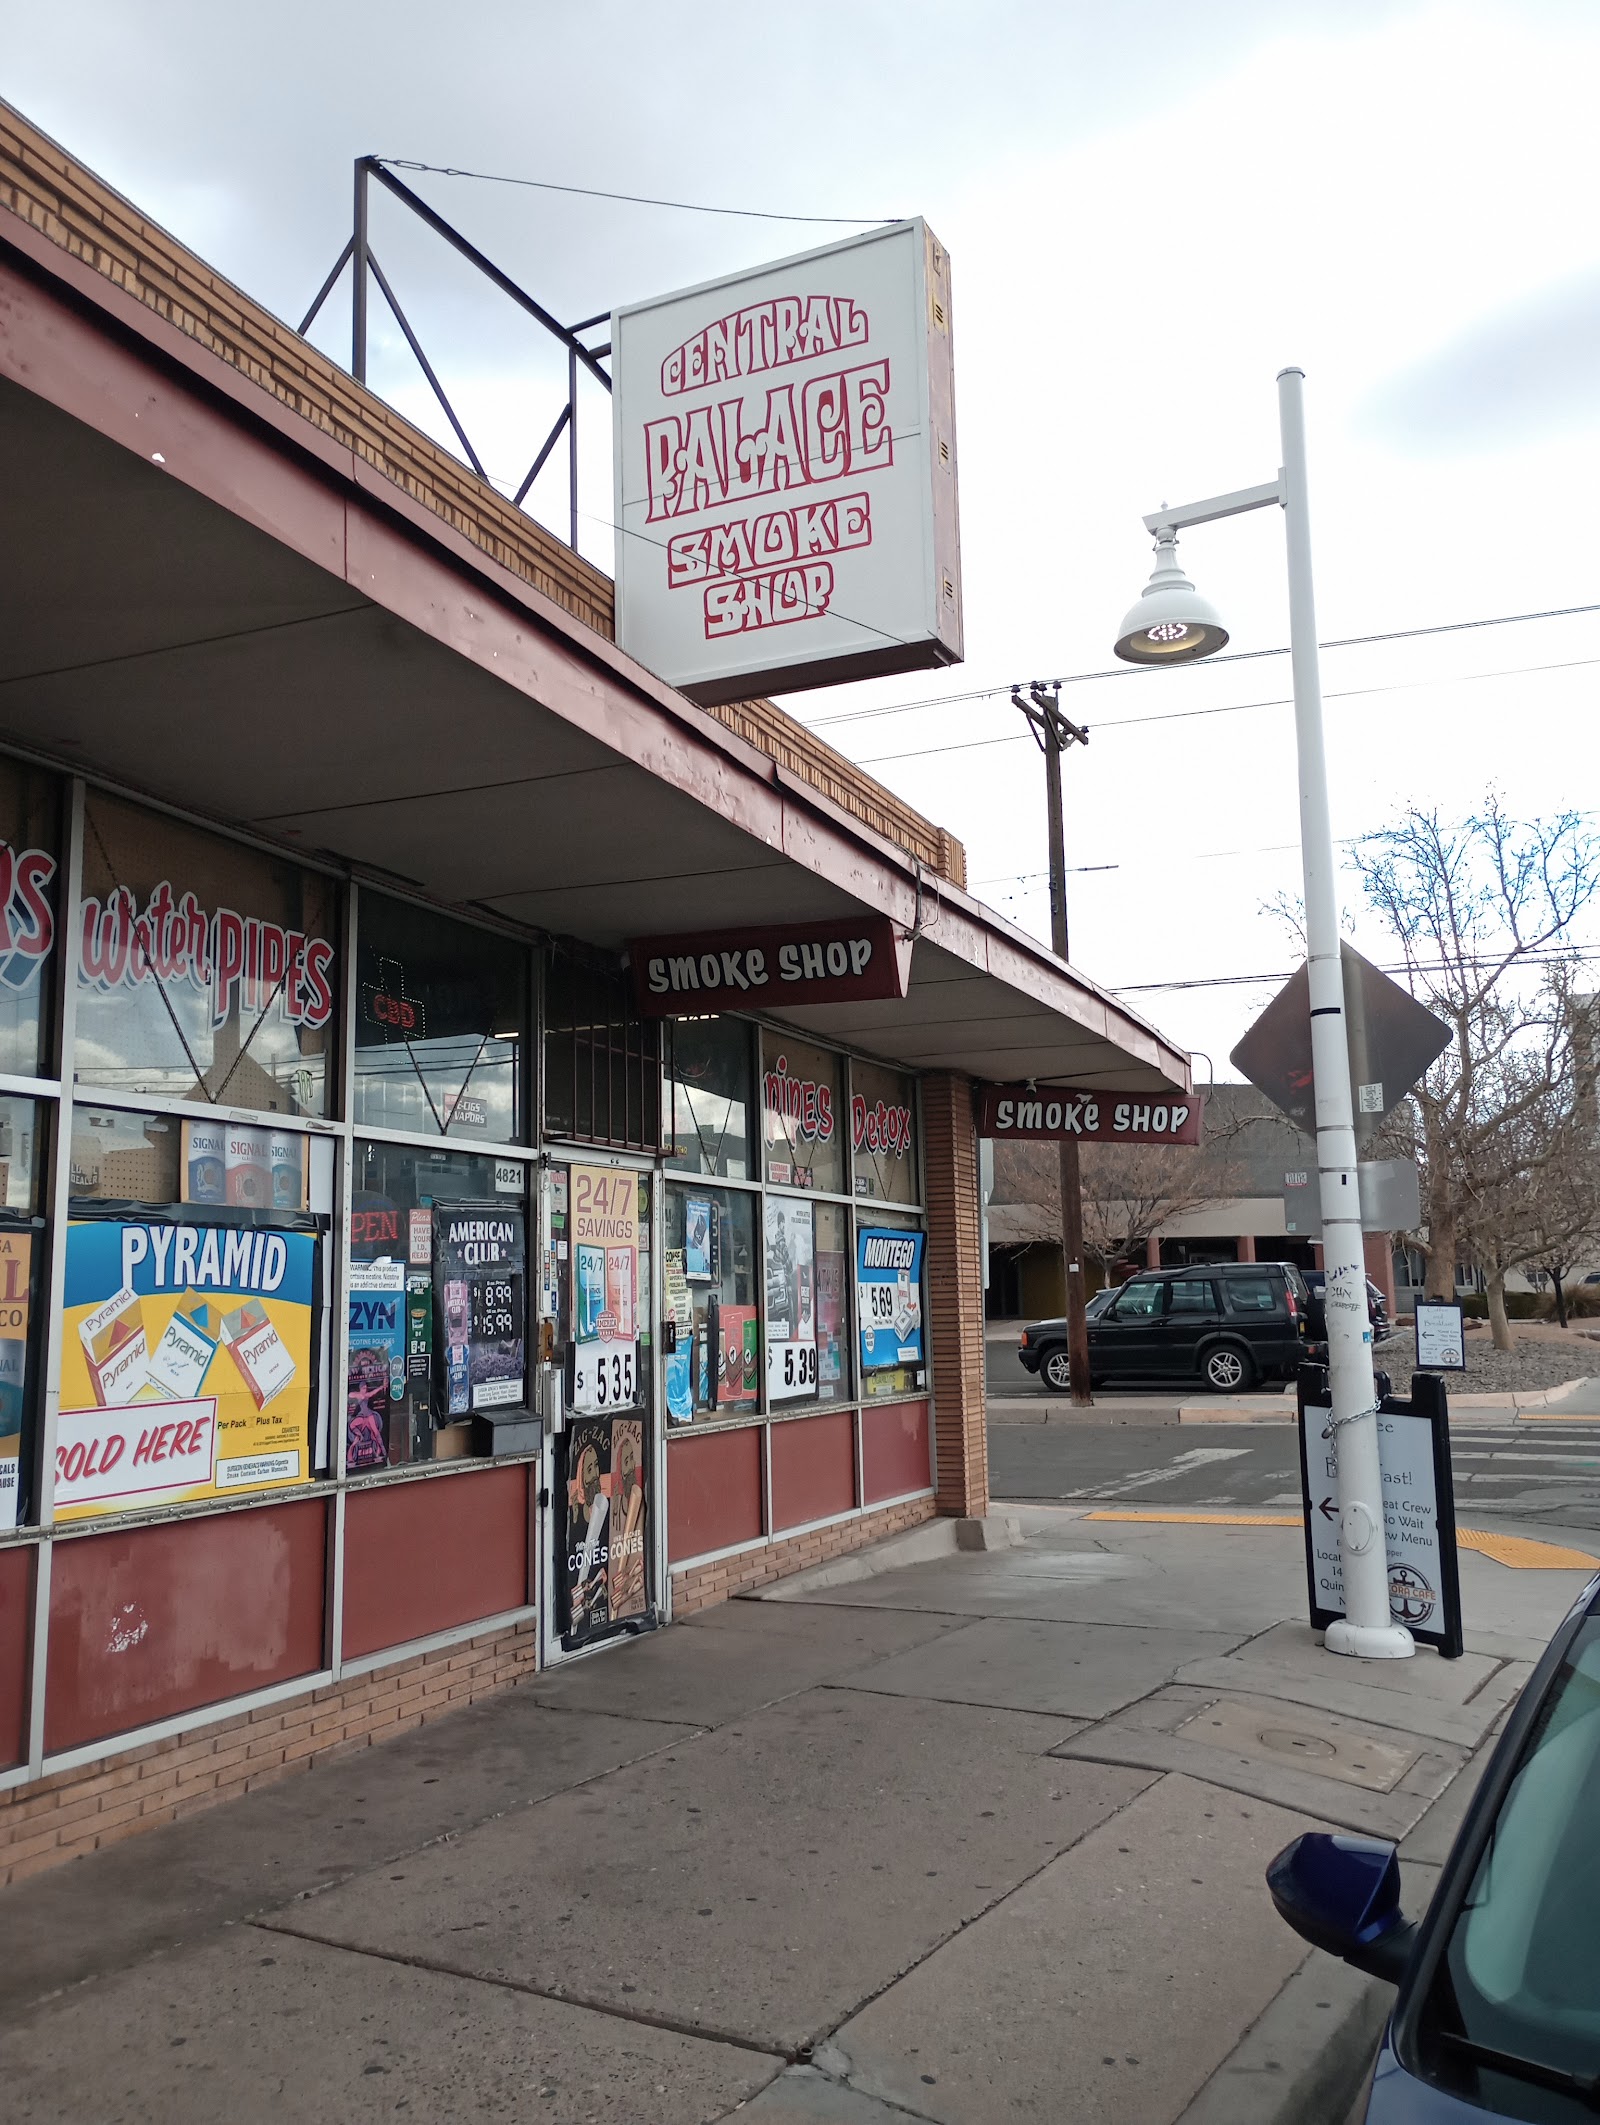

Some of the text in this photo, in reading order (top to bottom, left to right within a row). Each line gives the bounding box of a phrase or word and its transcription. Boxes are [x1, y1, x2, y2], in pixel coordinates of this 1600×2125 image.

[660, 296, 869, 397] CENTRAL
[643, 358, 894, 524] PALACE
[667, 491, 872, 590] SMOKE
[704, 561, 835, 640] SHOP
[207, 906, 335, 1031] PIPES
[779, 938, 872, 981] SHOP
[852, 1093, 912, 1160] Detox
[1112, 1103, 1189, 1134] SHOP
[230, 1141, 267, 1158] SIGNAL
[495, 1167, 522, 1184] 4821
[576, 1174, 633, 1216] 24/7
[351, 1210, 399, 1243] PEN
[413, 1227, 431, 1235] HAVE
[448, 1220, 514, 1244] AMERICAN
[576, 1217, 633, 1239] SAVINGS
[121, 1224, 287, 1293] PYRAMID
[464, 1242, 501, 1265] CLUB
[580, 1255, 603, 1273] 24/7
[608, 1255, 630, 1271] 24/7
[863, 1237, 916, 1269] MONTEGO
[85, 1289, 132, 1332] Pyramid
[473, 1285, 512, 1307] $ 8.99
[349, 1301, 396, 1331] ZYN
[473, 1313, 512, 1336] $ 15.99
[163, 1326, 209, 1368] Pyramid
[242, 1329, 279, 1365] Pyramid
[101, 1337, 146, 1389] Pyramid
[784, 1347, 816, 1387] 5.39
[576, 1353, 632, 1405] $ 5.35
[217, 1416, 283, 1430] Per Pack Plus Tax
[612, 1419, 641, 1450] ZIG-ZAG
[55, 1416, 212, 1486] SOLD HERE
[573, 1424, 611, 1457] ZIG-ZAG
[1398, 1515, 1425, 1530] Wait
[1402, 1500, 1432, 1514] Crew
[610, 1535, 644, 1560] CONES
[1401, 1531, 1433, 1547] Menu
[568, 1546, 609, 1572] CONES
[1412, 1589, 1436, 1601] CAFE
